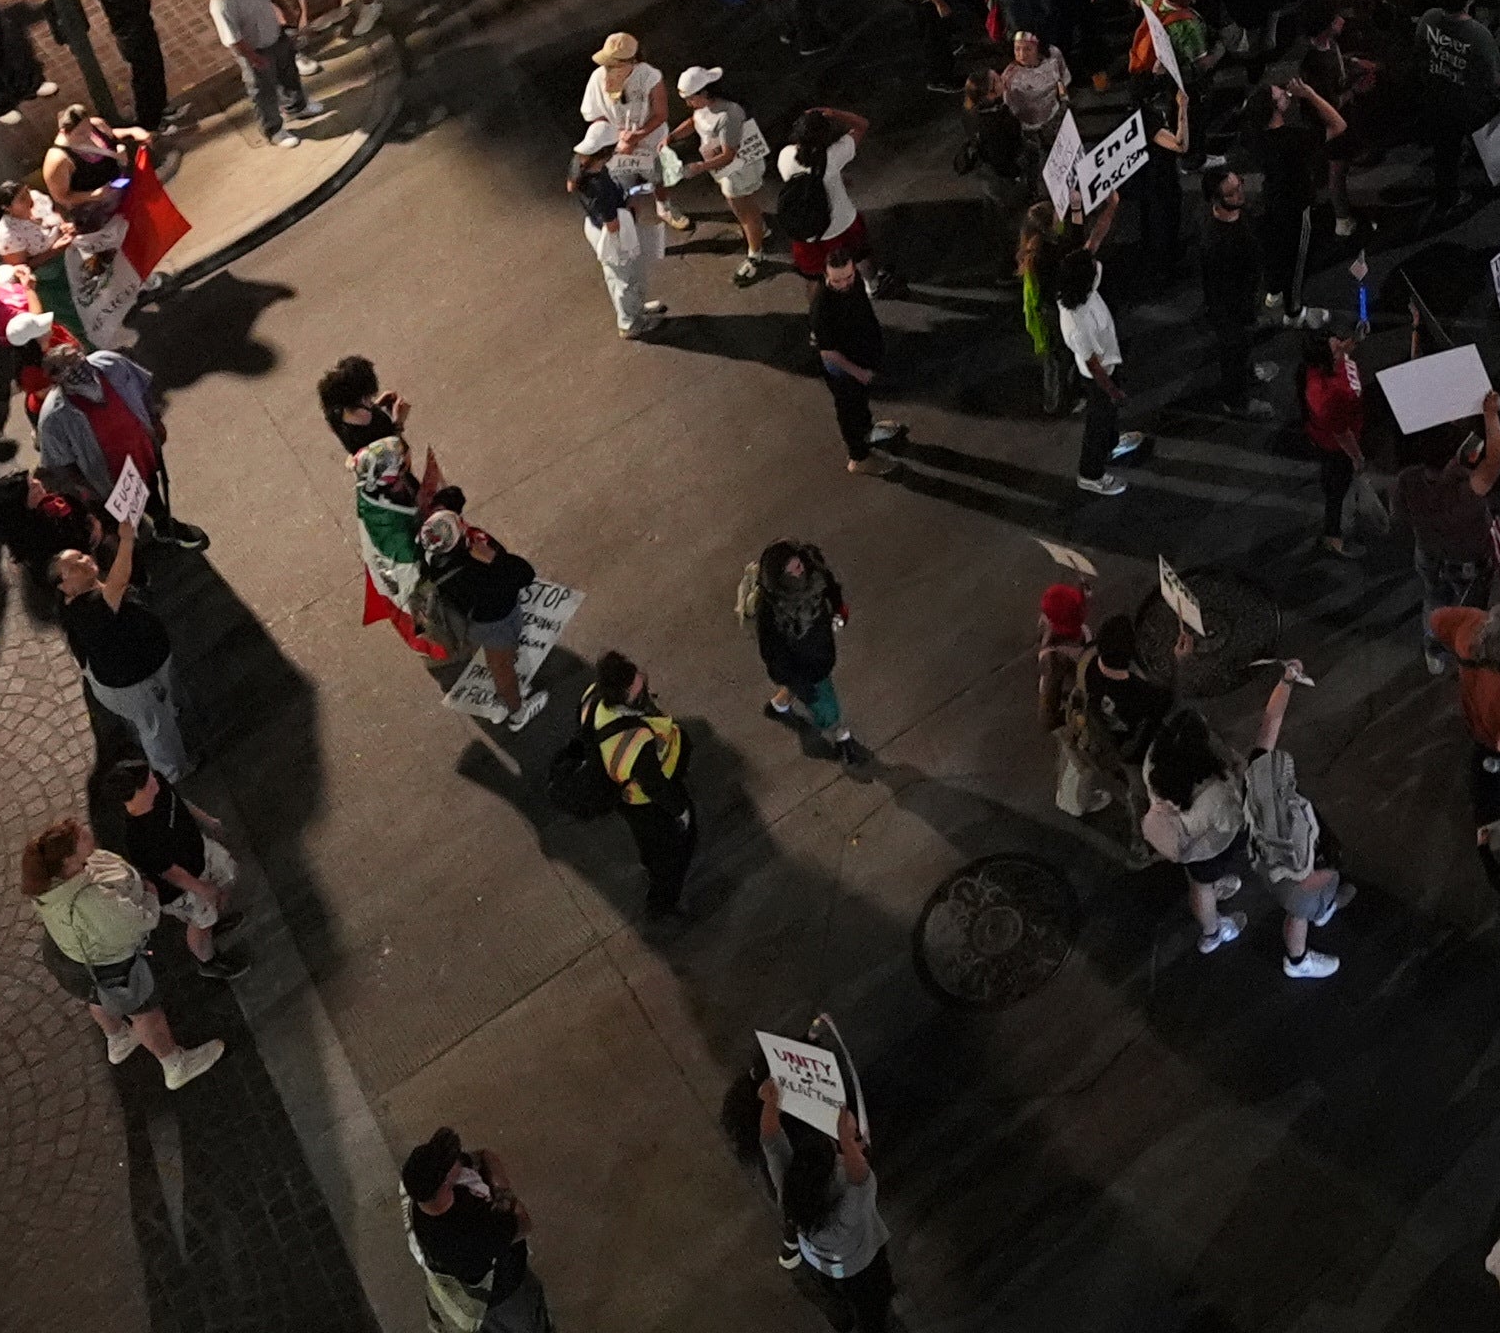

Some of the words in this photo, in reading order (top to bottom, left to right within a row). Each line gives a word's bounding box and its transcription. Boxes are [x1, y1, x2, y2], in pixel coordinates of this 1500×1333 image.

[1094, 118, 1138, 168] End
[113, 469, 135, 513] FUCK
[518, 583, 571, 610] STOP
[773, 1047, 832, 1077] UNITY
